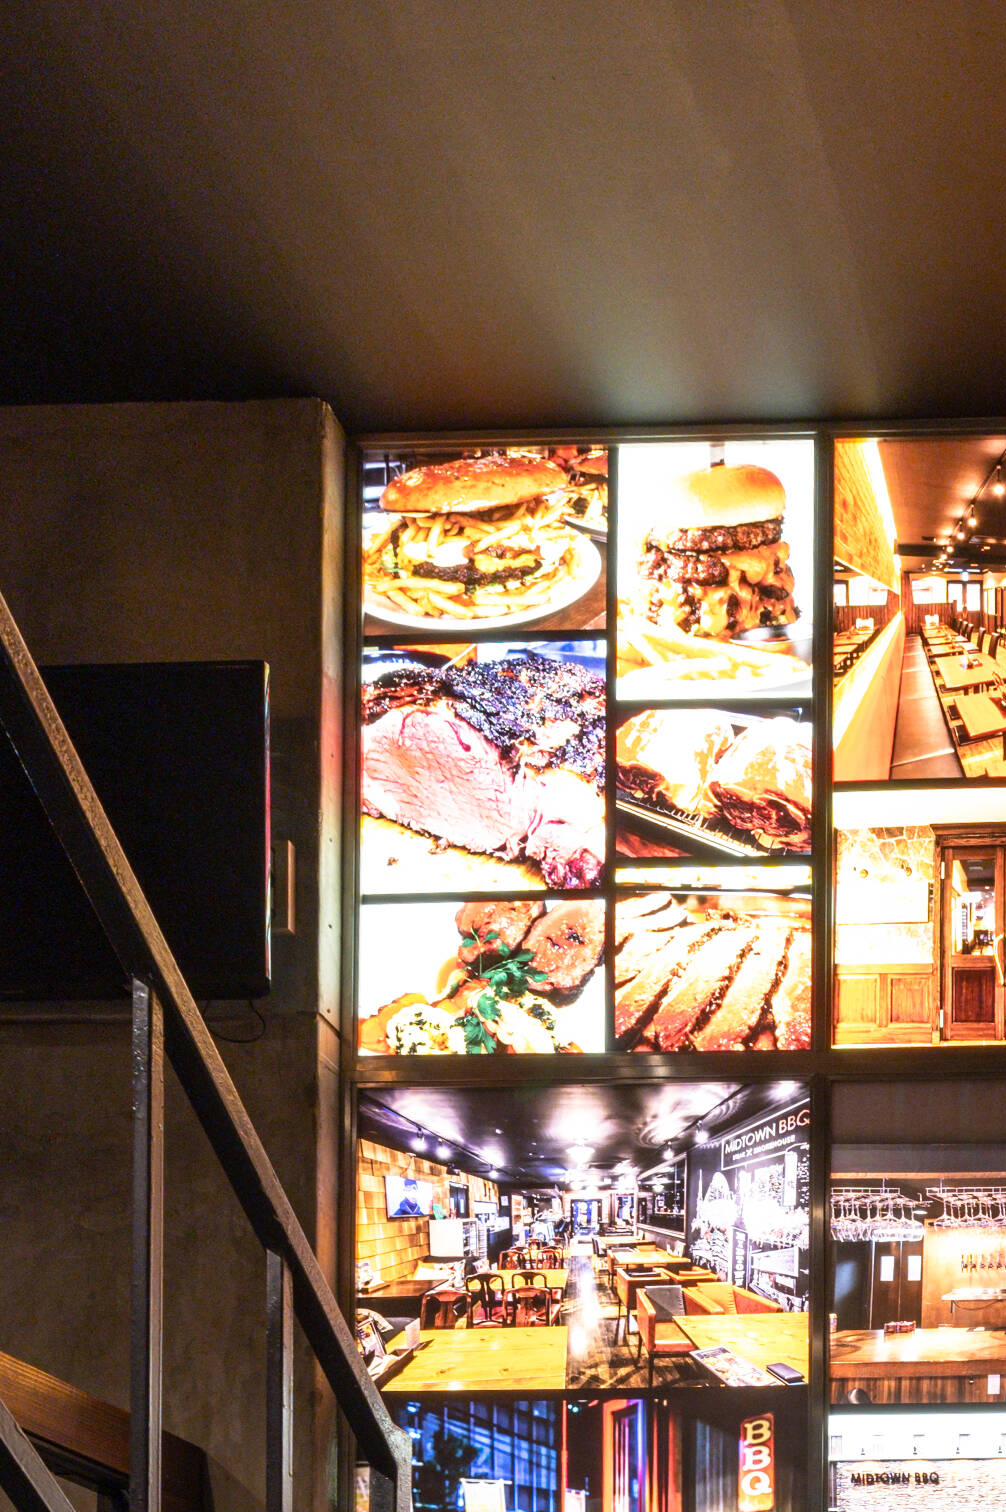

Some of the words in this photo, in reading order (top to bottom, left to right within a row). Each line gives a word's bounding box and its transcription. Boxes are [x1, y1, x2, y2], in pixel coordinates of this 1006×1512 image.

[724, 1122, 777, 1155] MIDTOWN
[742, 1419, 772, 1496] BBQ
[850, 1471, 910, 1487] MIDTOWN
